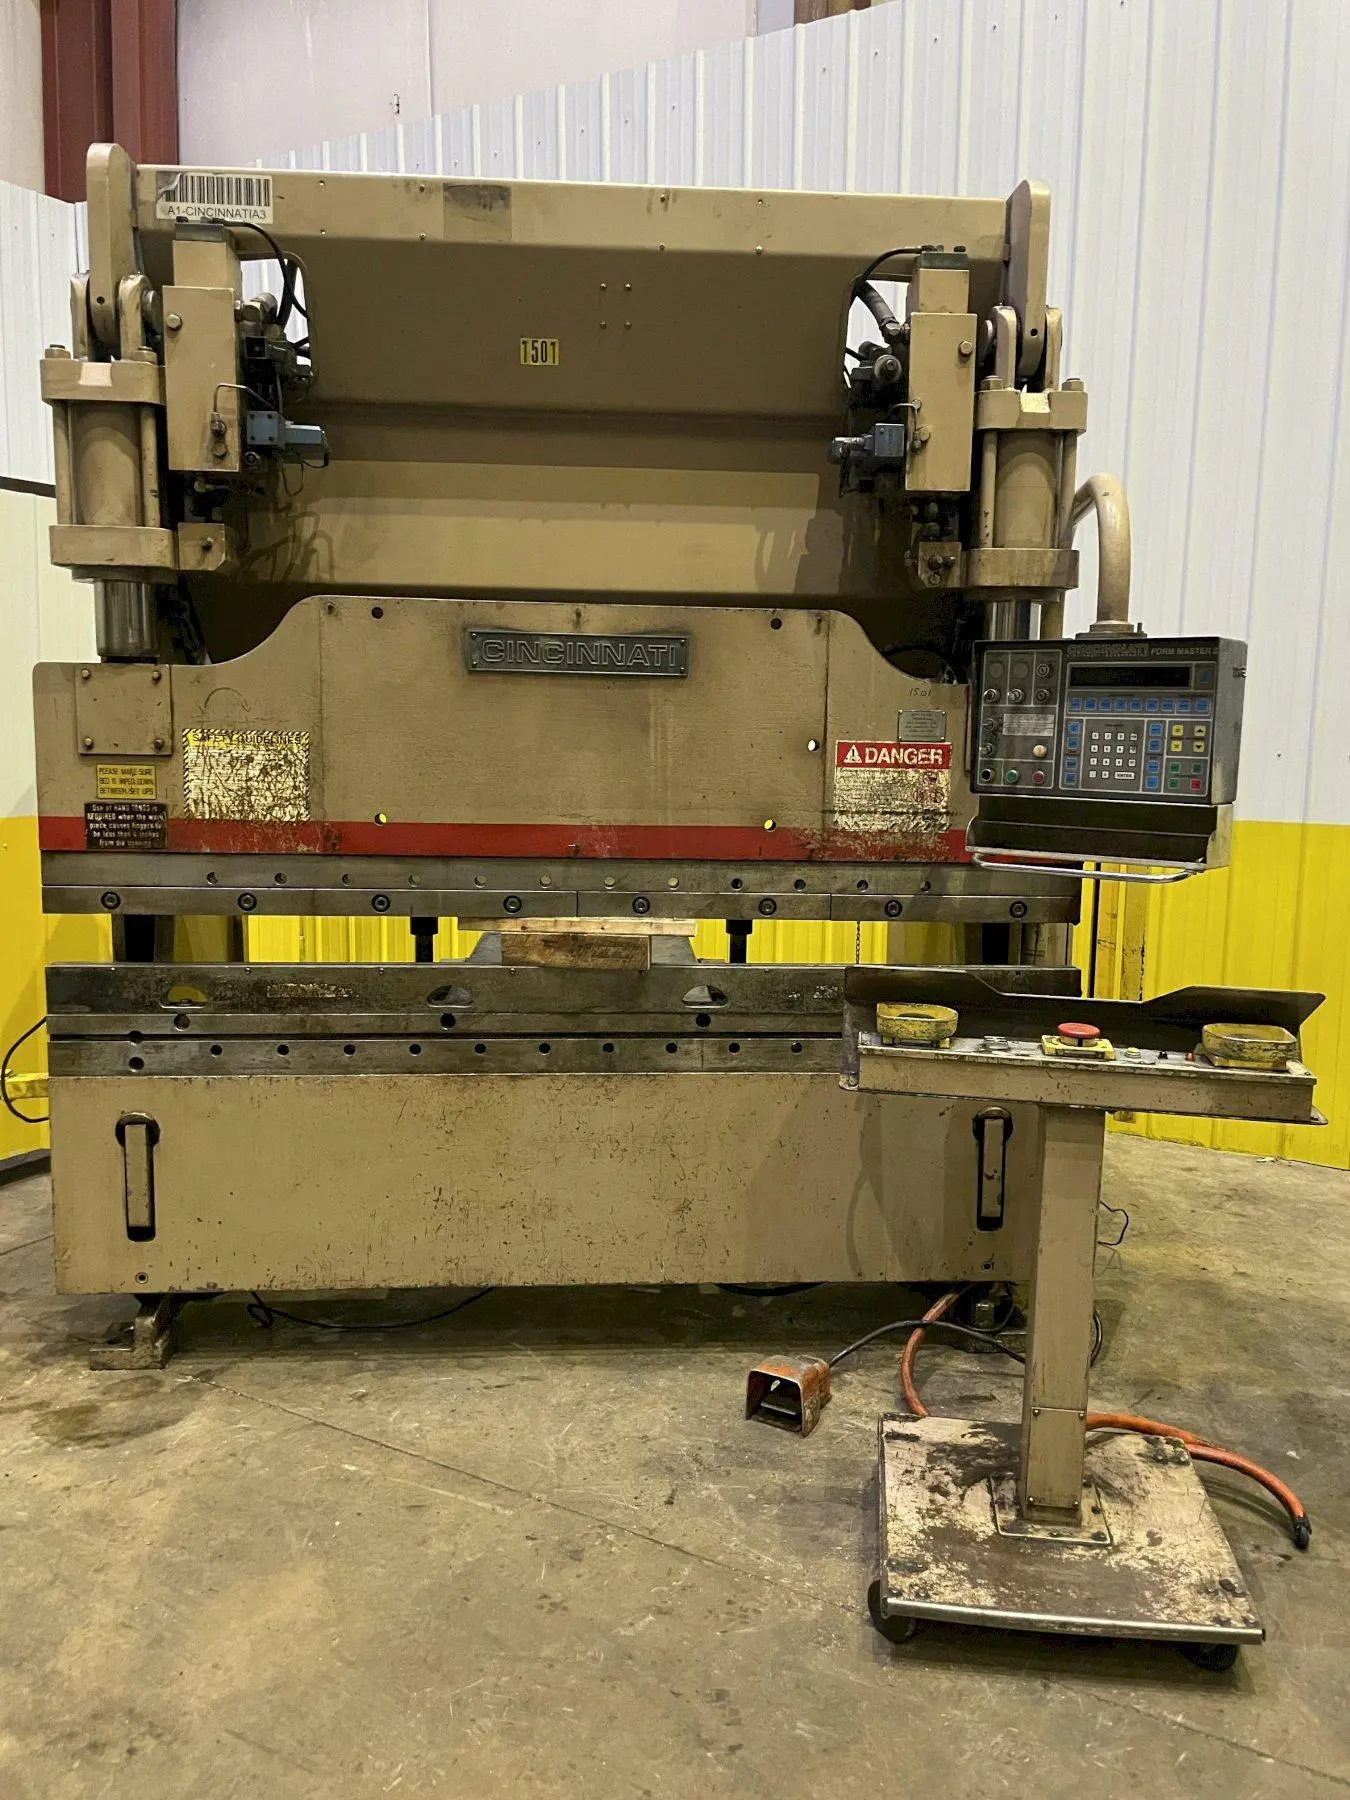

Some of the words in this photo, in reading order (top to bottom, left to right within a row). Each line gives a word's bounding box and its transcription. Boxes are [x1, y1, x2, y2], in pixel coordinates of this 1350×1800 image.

[167, 205, 267, 220] A1-CINCINNATIA3
[521, 339, 557, 365] 1501
[481, 639, 677, 667] CINCINNATI
[1150, 647, 1174, 655] FORM
[1176, 647, 1212, 655] MASTER
[909, 687, 932, 697] 1501
[864, 747, 943, 765] DANGER
[99, 767, 118, 775] PLEASE
[99, 777, 110, 785] BED
[99, 787, 127, 795] BETWEEN
[87, 812, 117, 821] REQUIRED
